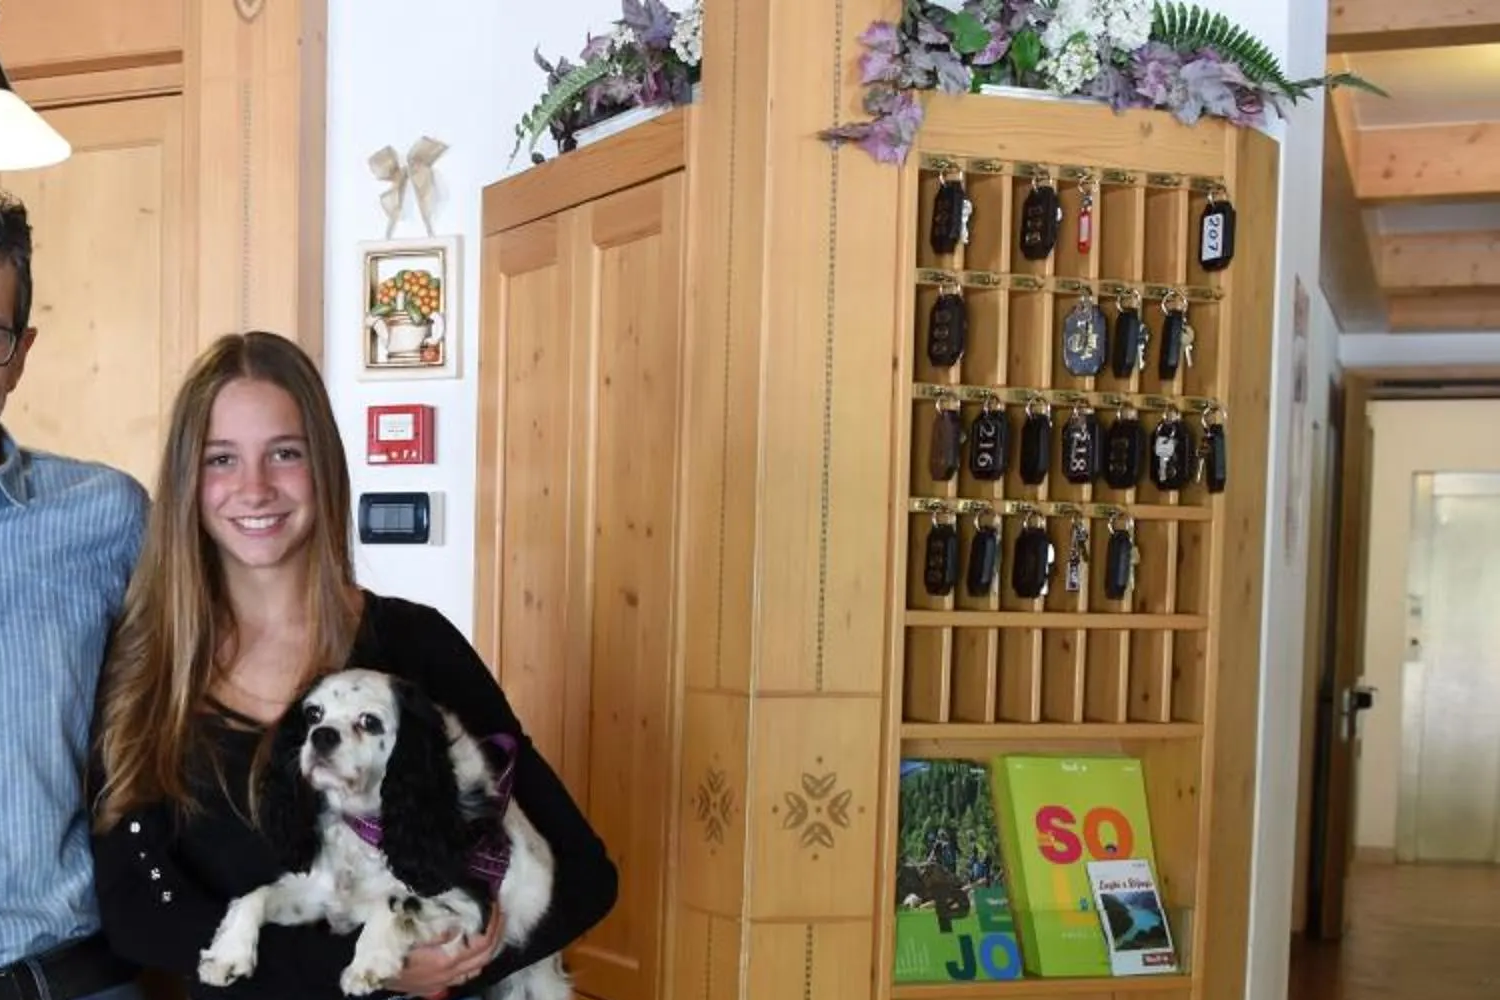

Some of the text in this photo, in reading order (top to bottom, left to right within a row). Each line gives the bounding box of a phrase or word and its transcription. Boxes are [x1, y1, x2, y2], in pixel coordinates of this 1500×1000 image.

[1206, 214, 1221, 254] 207
[975, 423, 997, 469] 216
[1035, 804, 1134, 865] SO
[945, 931, 1024, 982] JO
